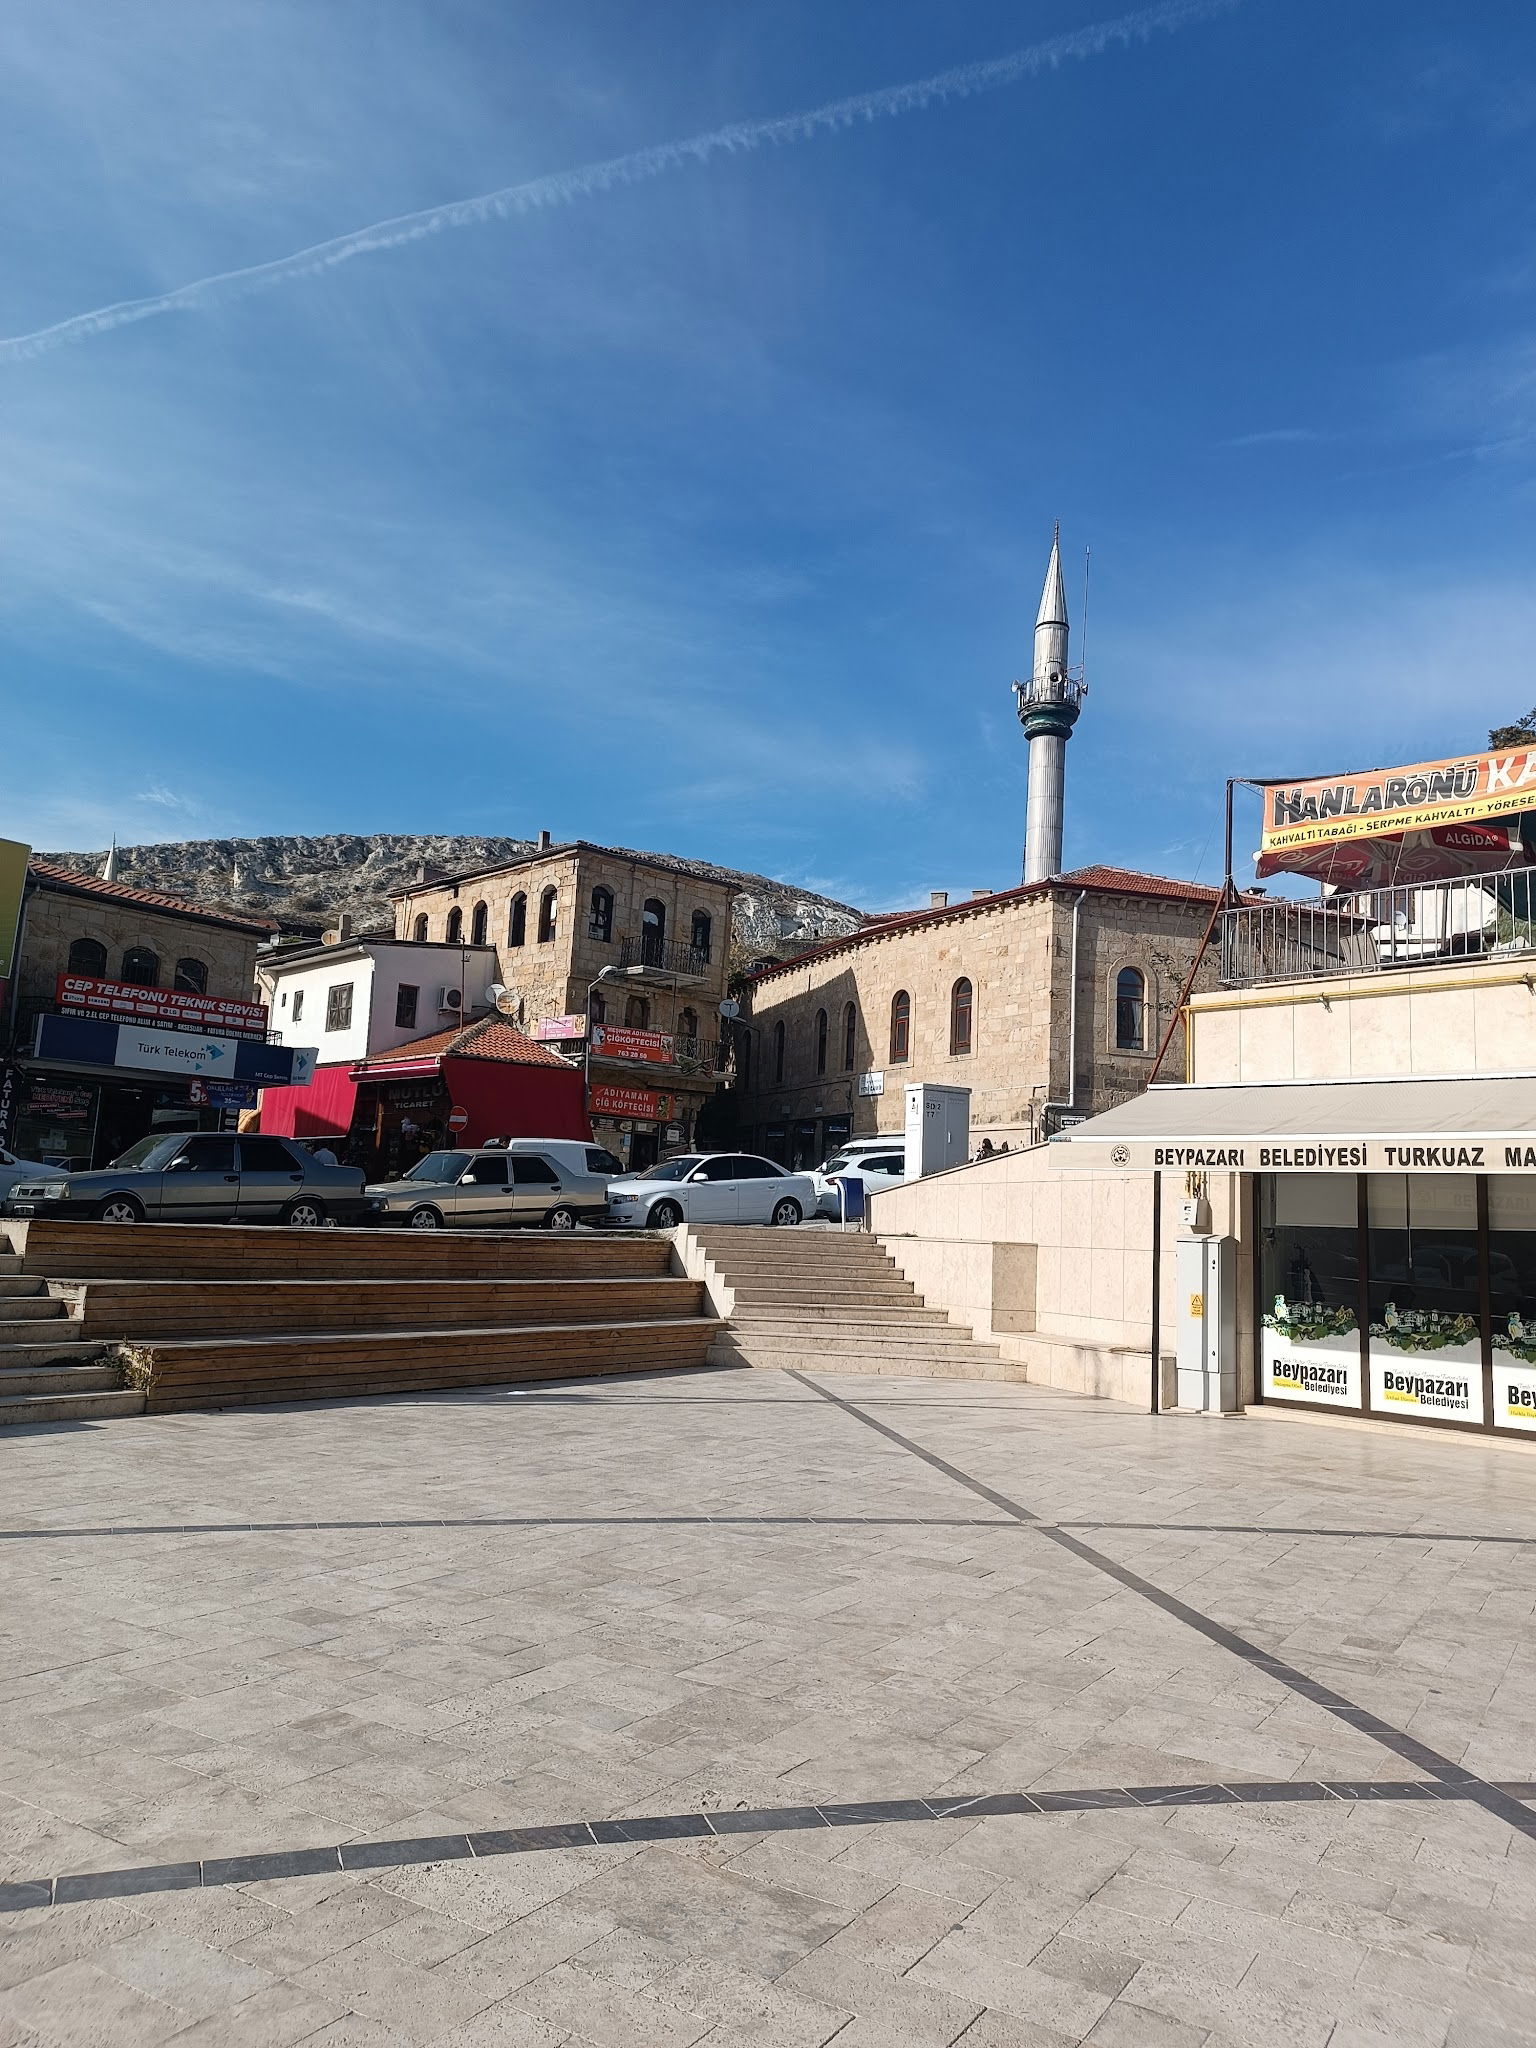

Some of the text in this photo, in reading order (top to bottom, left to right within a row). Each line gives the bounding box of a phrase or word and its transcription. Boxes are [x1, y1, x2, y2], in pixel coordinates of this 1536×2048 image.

[1270, 830, 1316, 847] KAHVALTI
[1317, 823, 1357, 838] TABAĞI
[1366, 816, 1412, 831] SERPME
[1415, 807, 1475, 823] KAHVALTI
[1487, 795, 1536, 812] YÖRESE
[64, 979, 94, 992] CEP
[97, 983, 168, 1003] TELEFONU
[98, 1012, 110, 1020] CEP
[111, 1014, 137, 1023] TELEFONU
[138, 1043, 206, 1060] Türk Telekom
[617, 1049, 629, 1057] 763
[603, 1088, 649, 1101] ADIYAMAN
[595, 1098, 609, 1108] ÇİĞ
[612, 1100, 654, 1113] KÖFTECİSİ
[1154, 1148, 1244, 1166] BEYPAZARI
[1260, 1142, 1367, 1166] BELEDİYESİ
[1384, 1147, 1485, 1166] TURKUAZ
[1273, 1359, 1347, 1384] Beypazarı
[1304, 1381, 1347, 1395] Belediyesi
[1384, 1371, 1469, 1397] Beypazarı
[1420, 1394, 1469, 1409] Belediyesi
